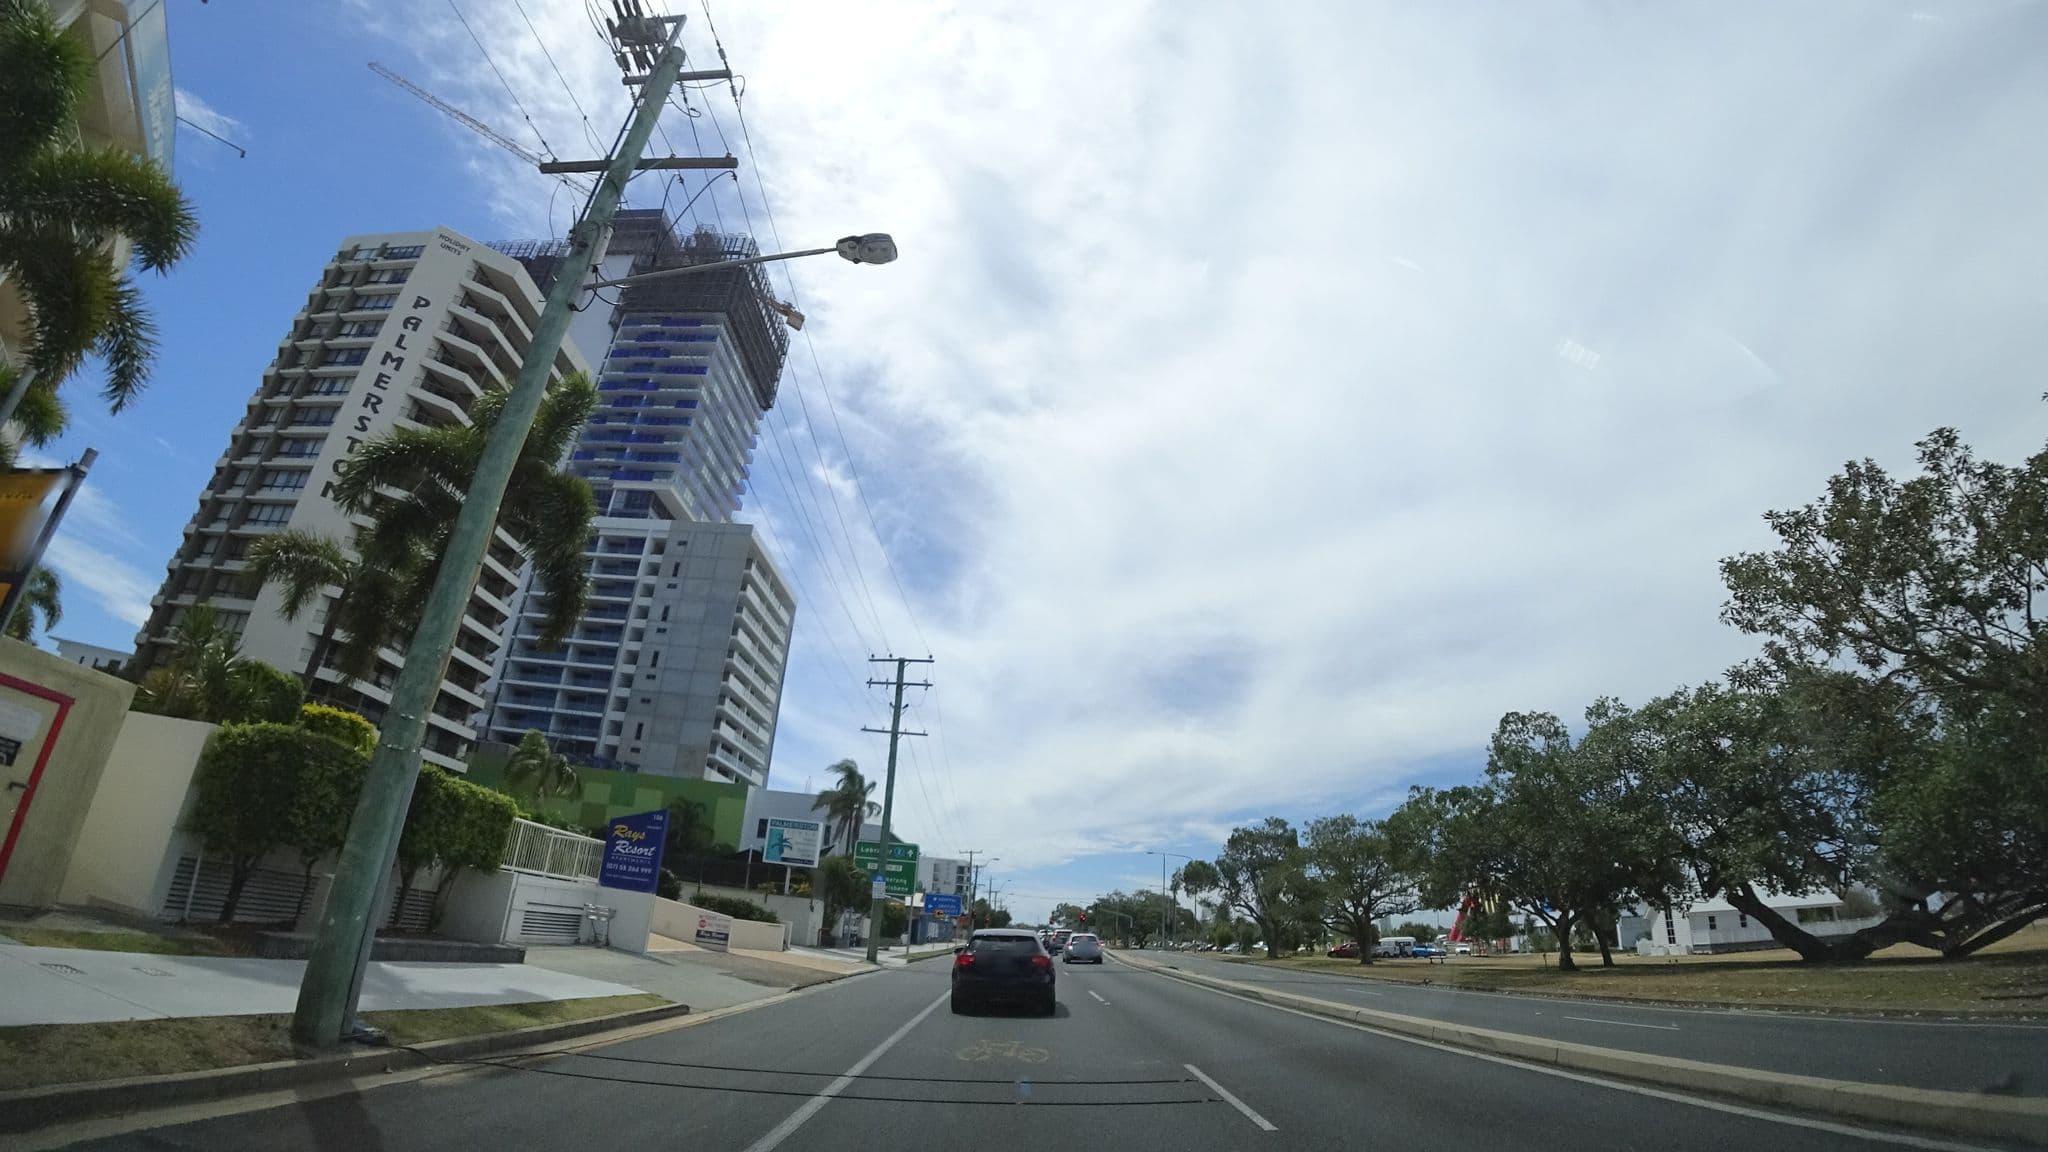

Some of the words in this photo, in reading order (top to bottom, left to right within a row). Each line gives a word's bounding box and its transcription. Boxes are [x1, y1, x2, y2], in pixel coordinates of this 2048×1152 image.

[439, 233, 471, 252] HOLIDAY
[440, 242, 461, 256] UNITS
[612, 824, 646, 842] Rays
[613, 840, 656, 857] Resort
